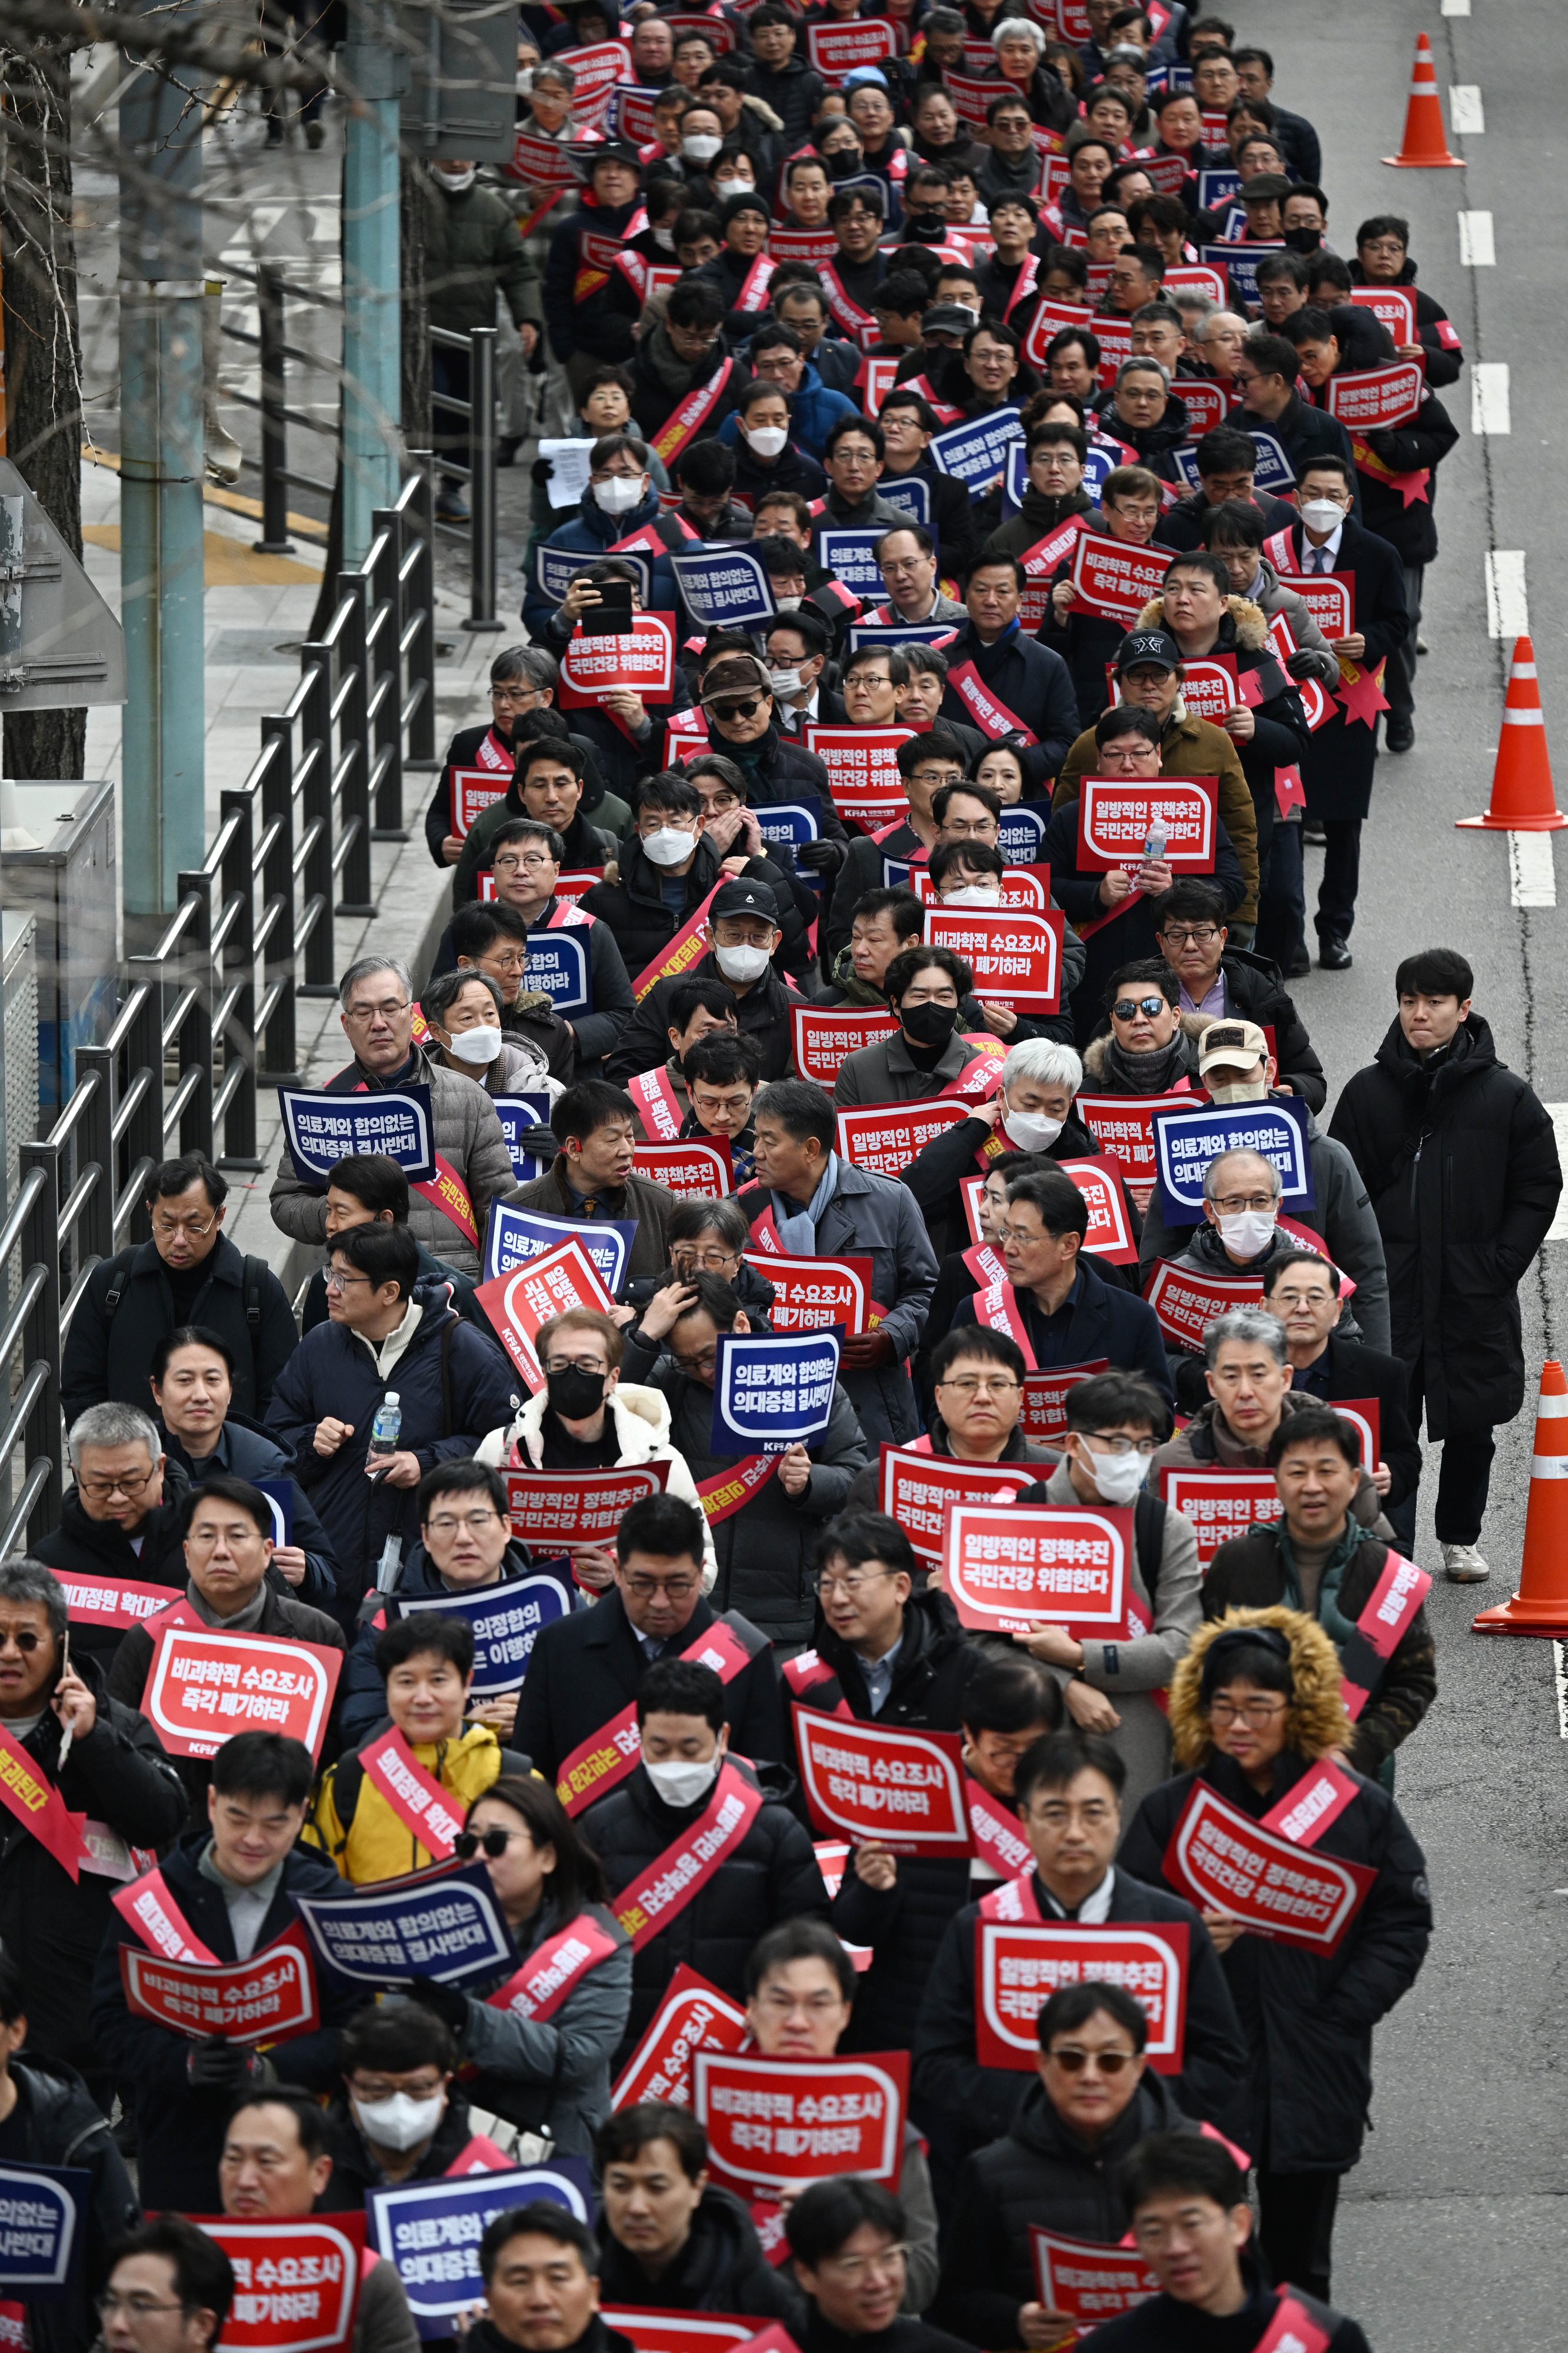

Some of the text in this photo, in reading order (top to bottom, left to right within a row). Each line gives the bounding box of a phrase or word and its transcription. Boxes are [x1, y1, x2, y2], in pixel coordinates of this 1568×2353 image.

[1374, 305, 1404, 319] 요조사
[1187, 396, 1219, 410] 요조사
[1337, 375, 1415, 404] 일방적인 정책추진
[1337, 393, 1414, 419] 국민건강 위협한다
[944, 441, 985, 465] 의료계와
[950, 452, 990, 476] 의대증원
[709, 567, 755, 588] 합의없는
[832, 565, 878, 584] 의대증원
[1086, 552, 1132, 577] 비과학적
[714, 586, 760, 608] 결사반대
[1094, 572, 1159, 601] 즉각 폐기하
[1305, 594, 1342, 611] 책추진
[569, 634, 664, 655] 일방적인 정책추진
[569, 653, 664, 675] 국민건강 위협한다
[958, 675, 995, 719] 일방적인
[818, 747, 896, 767] 일방적인 정책
[845, 809, 868, 817] KMA
[1096, 800, 1201, 819] 일방적인 정책추진
[1094, 822, 1200, 841] 국민건강 협한다
[1120, 862, 1143, 871] KMA
[660, 934, 703, 979] 의료체계
[934, 930, 1046, 955] 비과학적 수요조사
[975, 955, 1031, 977] 폐기하라
[806, 1029, 863, 1048] 일방적인
[297, 1113, 414, 1136] 의료계와 합의없는
[1089, 1121, 1142, 1140] 비과학적
[302, 1133, 416, 1158] 의대증원 결사반대
[852, 1127, 910, 1153] 일방적인
[1105, 1144, 1132, 1164] 즉각
[1171, 1127, 1290, 1159] 의료계와 합의없는
[655, 1161, 715, 1186] 정책추진
[854, 1148, 913, 1172] 국민건강
[438, 1175, 472, 1219] 국민건강
[588, 1247, 615, 1268] 없는
[790, 1284, 852, 1306] 수요조사
[1165, 1283, 1226, 1314] 일방적인
[773, 1309, 836, 1327] 폐기하라
[502, 1328, 521, 1356] KMA
[519, 1353, 539, 1384] 대한의사협회
[735, 1358, 835, 1387] 의료계와 합의없는
[733, 1382, 831, 1413] 의대증원 결사반대
[763, 1442, 793, 1452] KMA
[512, 1484, 649, 1510] 일방적인 정책추진
[897, 1478, 960, 1508] 일방적인
[509, 1511, 578, 1530] 국민건강
[1182, 1498, 1250, 1521] 일방적인
[538, 1547, 570, 1557] KMA
[964, 1534, 1110, 1565] 일방적인 정책추진
[963, 1562, 1109, 1595] 국민건강 위협한다
[1377, 1557, 1420, 1627] 일방적인
[473, 1601, 542, 1641] 의정합의
[171, 1657, 315, 1699] 비과학적 수요조사
[181, 1687, 290, 1724] 즉각 폐기하라
[568, 1744, 622, 1795] 국민건강
[811, 1740, 945, 1790] 비과학적 수요조사
[376, 1746, 429, 1815] 의대정원
[828, 1773, 930, 1816] 즉각 폐기하라
[1277, 1776, 1339, 1843] 의대정원
[638, 1793, 746, 1916] 일방적인 정책추진
[1199, 1818, 1343, 1904] 일방적인 정책추진
[1188, 1841, 1332, 1923] 국민건강 위협한다
[132, 1889, 184, 1964] 의대정원
[323, 1918, 396, 1942] 의료계와
[398, 1900, 478, 1938] 합의없는
[332, 1921, 488, 1965] 의대증원 결사반대
[142, 1961, 296, 2005] 비과학적 수요조사
[999, 1957, 1163, 1991] 일방적인 정책추진
[203, 1994, 281, 2025] 폐기하라
[710, 2085, 883, 2123] 비과학적 수요조사
[730, 2121, 862, 2155] 즉각 폐기하라
[395, 2213, 483, 2251] 의료계와
[256, 2255, 342, 2286] 수요조사
[399, 2248, 482, 2286] 의대증원
[232, 2289, 322, 2325] 폐기하라
